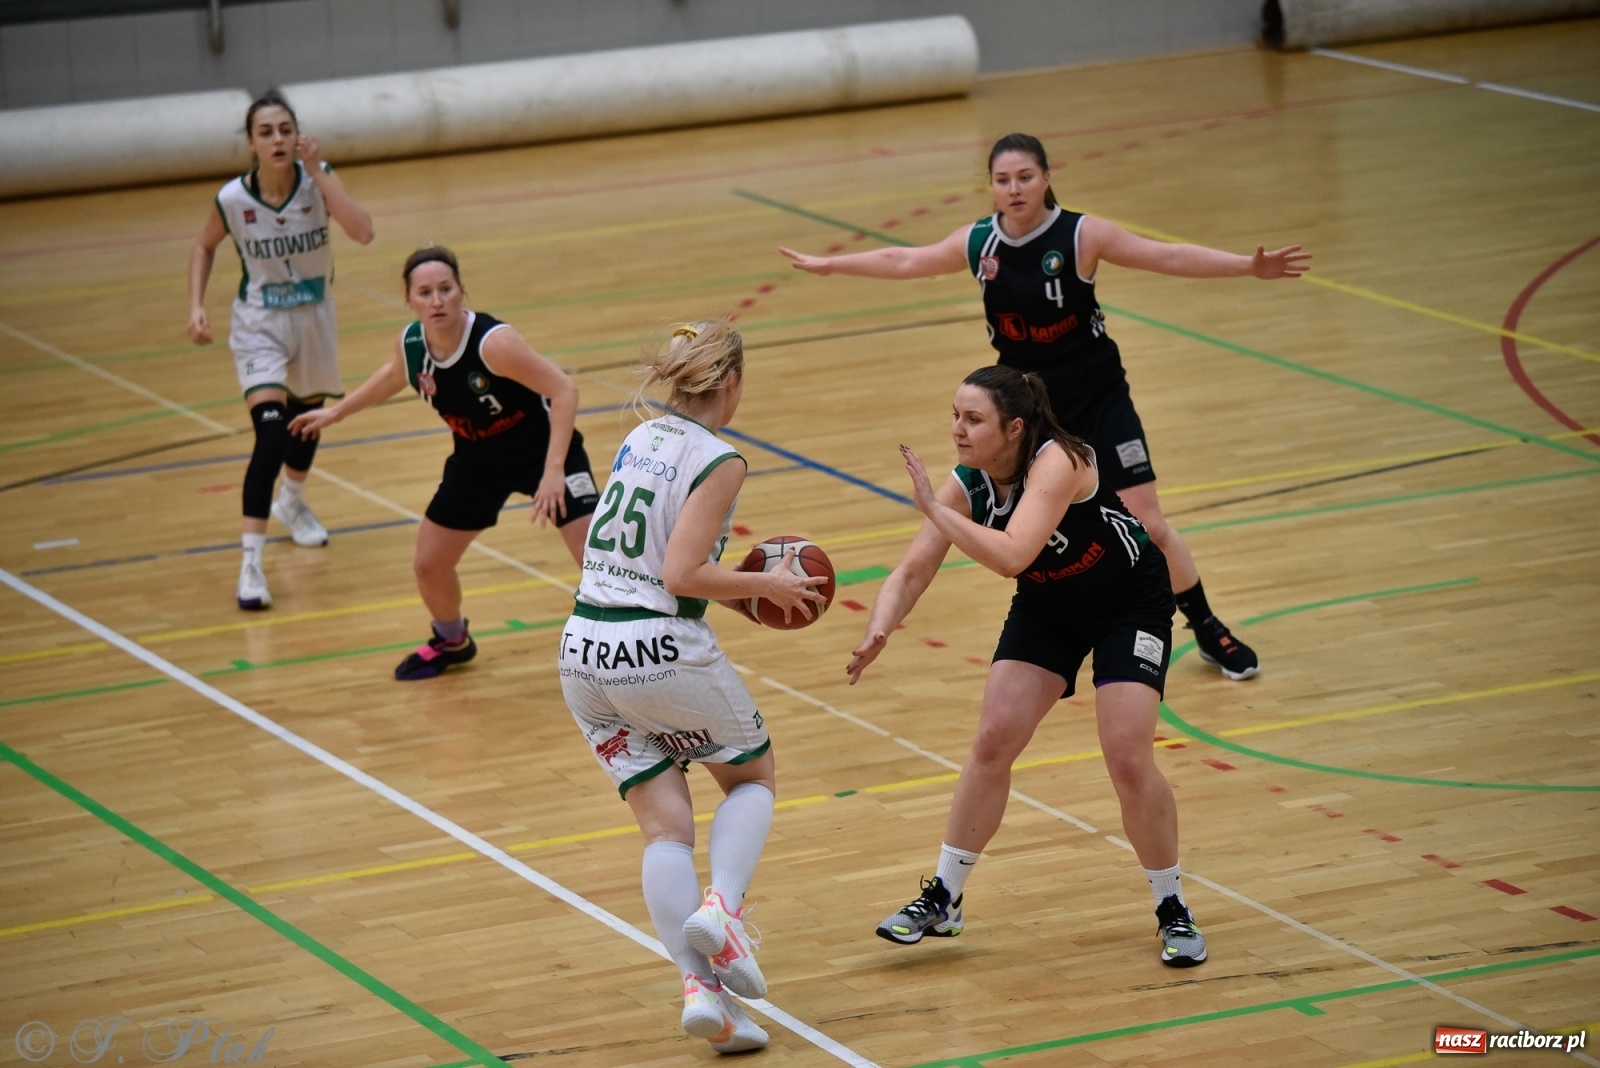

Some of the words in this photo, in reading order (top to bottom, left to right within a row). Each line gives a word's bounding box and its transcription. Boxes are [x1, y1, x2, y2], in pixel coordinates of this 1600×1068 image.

[244, 226, 330, 260] KATOWICE
[1045, 278, 1064, 309] 4
[478, 394, 503, 416] 3
[588, 480, 656, 559] 25
[607, 564, 665, 590] KATOWICE
